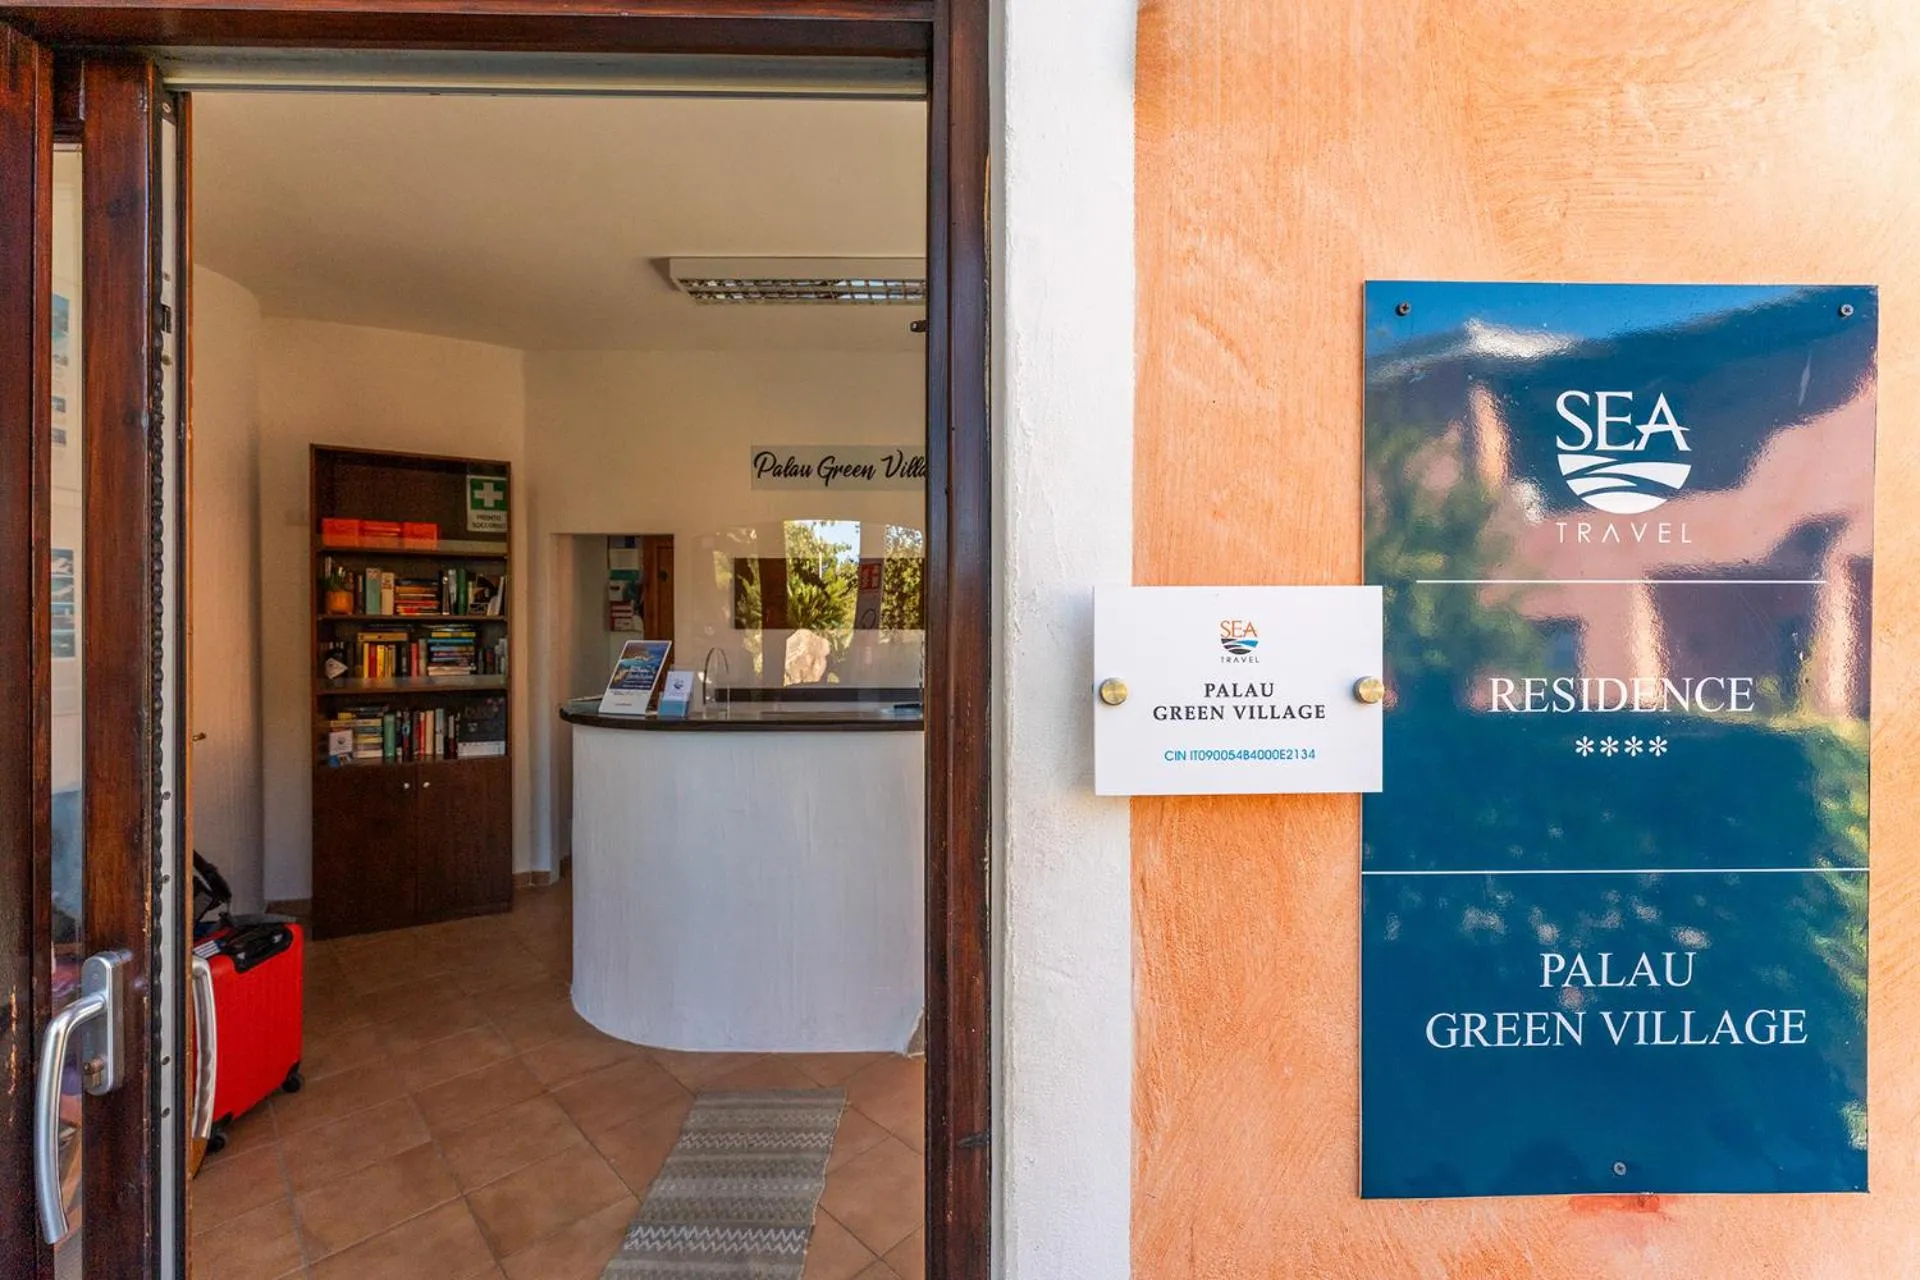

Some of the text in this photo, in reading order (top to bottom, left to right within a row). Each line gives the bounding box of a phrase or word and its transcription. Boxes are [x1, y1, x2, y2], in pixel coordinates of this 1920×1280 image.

[1555, 389, 1692, 453] SEA
[753, 450, 813, 479] Palau
[817, 455, 876, 487] Green
[1556, 521, 1693, 545] TRAVEL
[1219, 619, 1258, 638] SEA
[1220, 655, 1260, 664] TRAVEL
[1203, 682, 1275, 698] PALAU
[1489, 676, 1755, 714] RESIDENCE
[1152, 704, 1326, 721] GREEN VILLAGE
[1164, 749, 1187, 762] CIN
[1539, 950, 1696, 989] PALAU
[1425, 1008, 1810, 1050] GREEN VILLAGE
